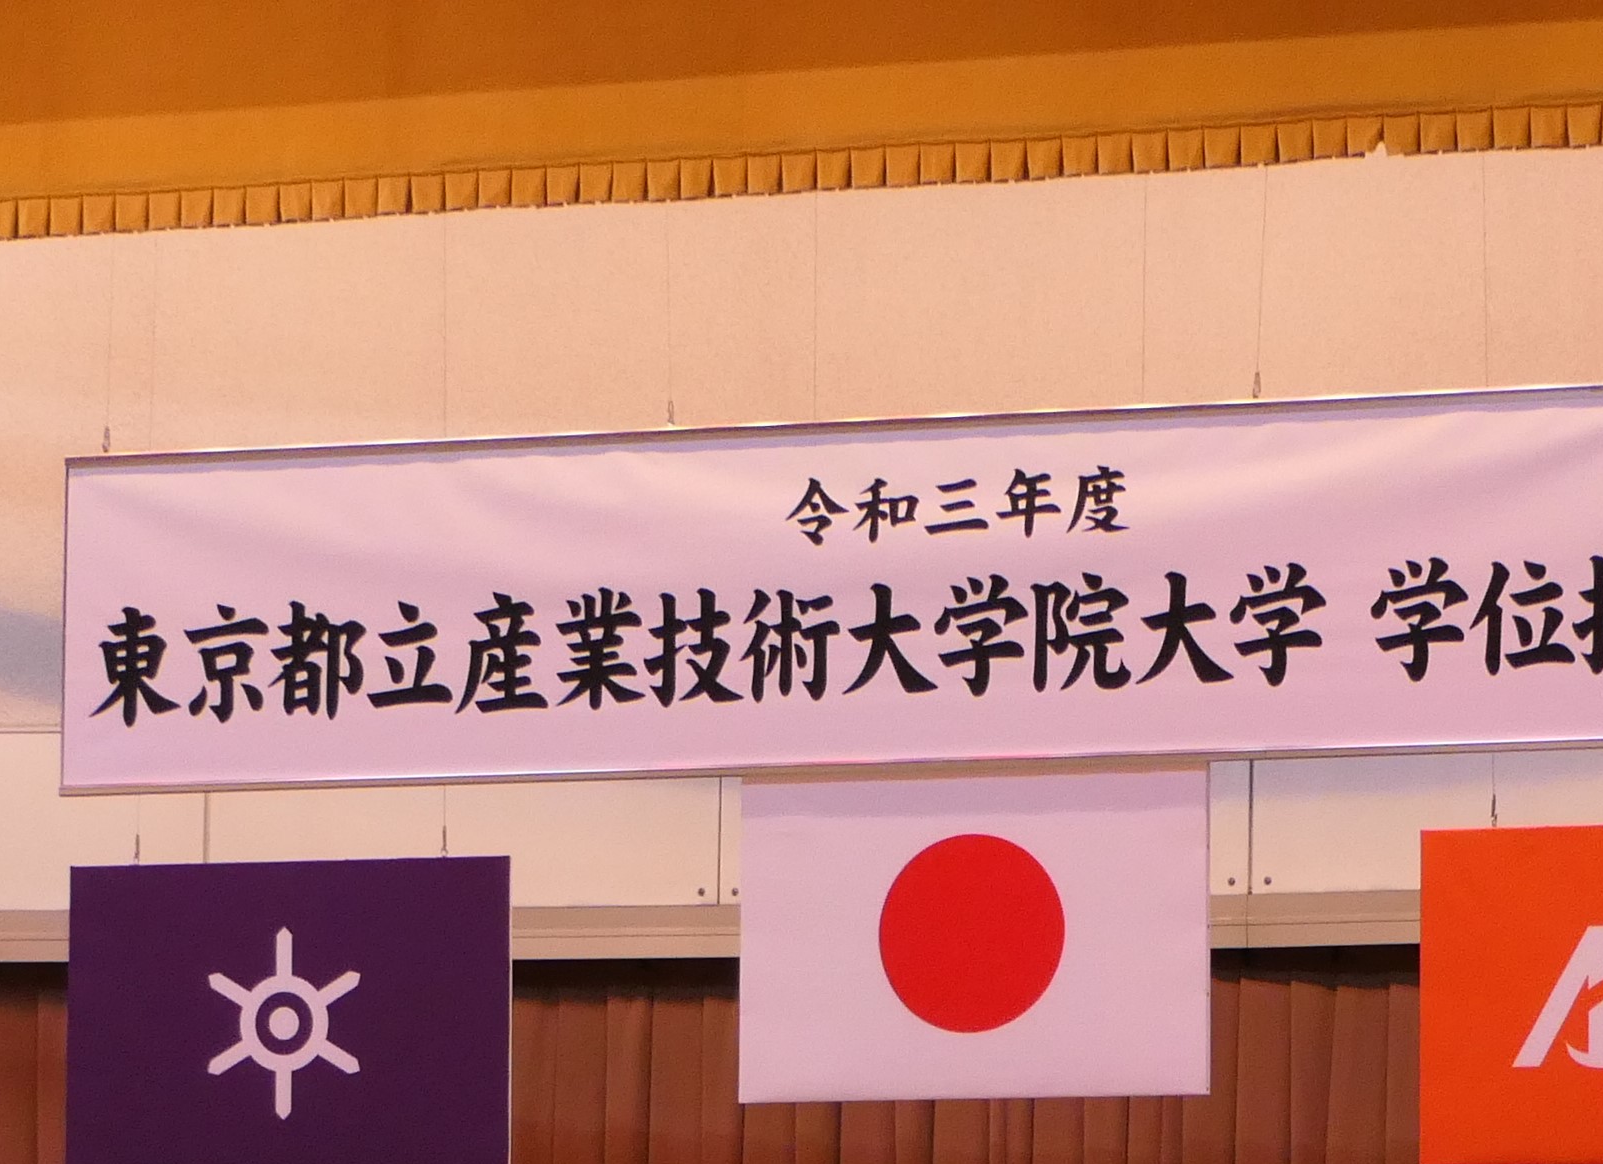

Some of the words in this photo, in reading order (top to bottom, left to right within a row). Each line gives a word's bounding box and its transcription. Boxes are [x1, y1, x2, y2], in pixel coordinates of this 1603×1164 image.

[787, 464, 1128, 546] 令和三年度
[91, 563, 1327, 727] 東京都立産業技術大学院大学
